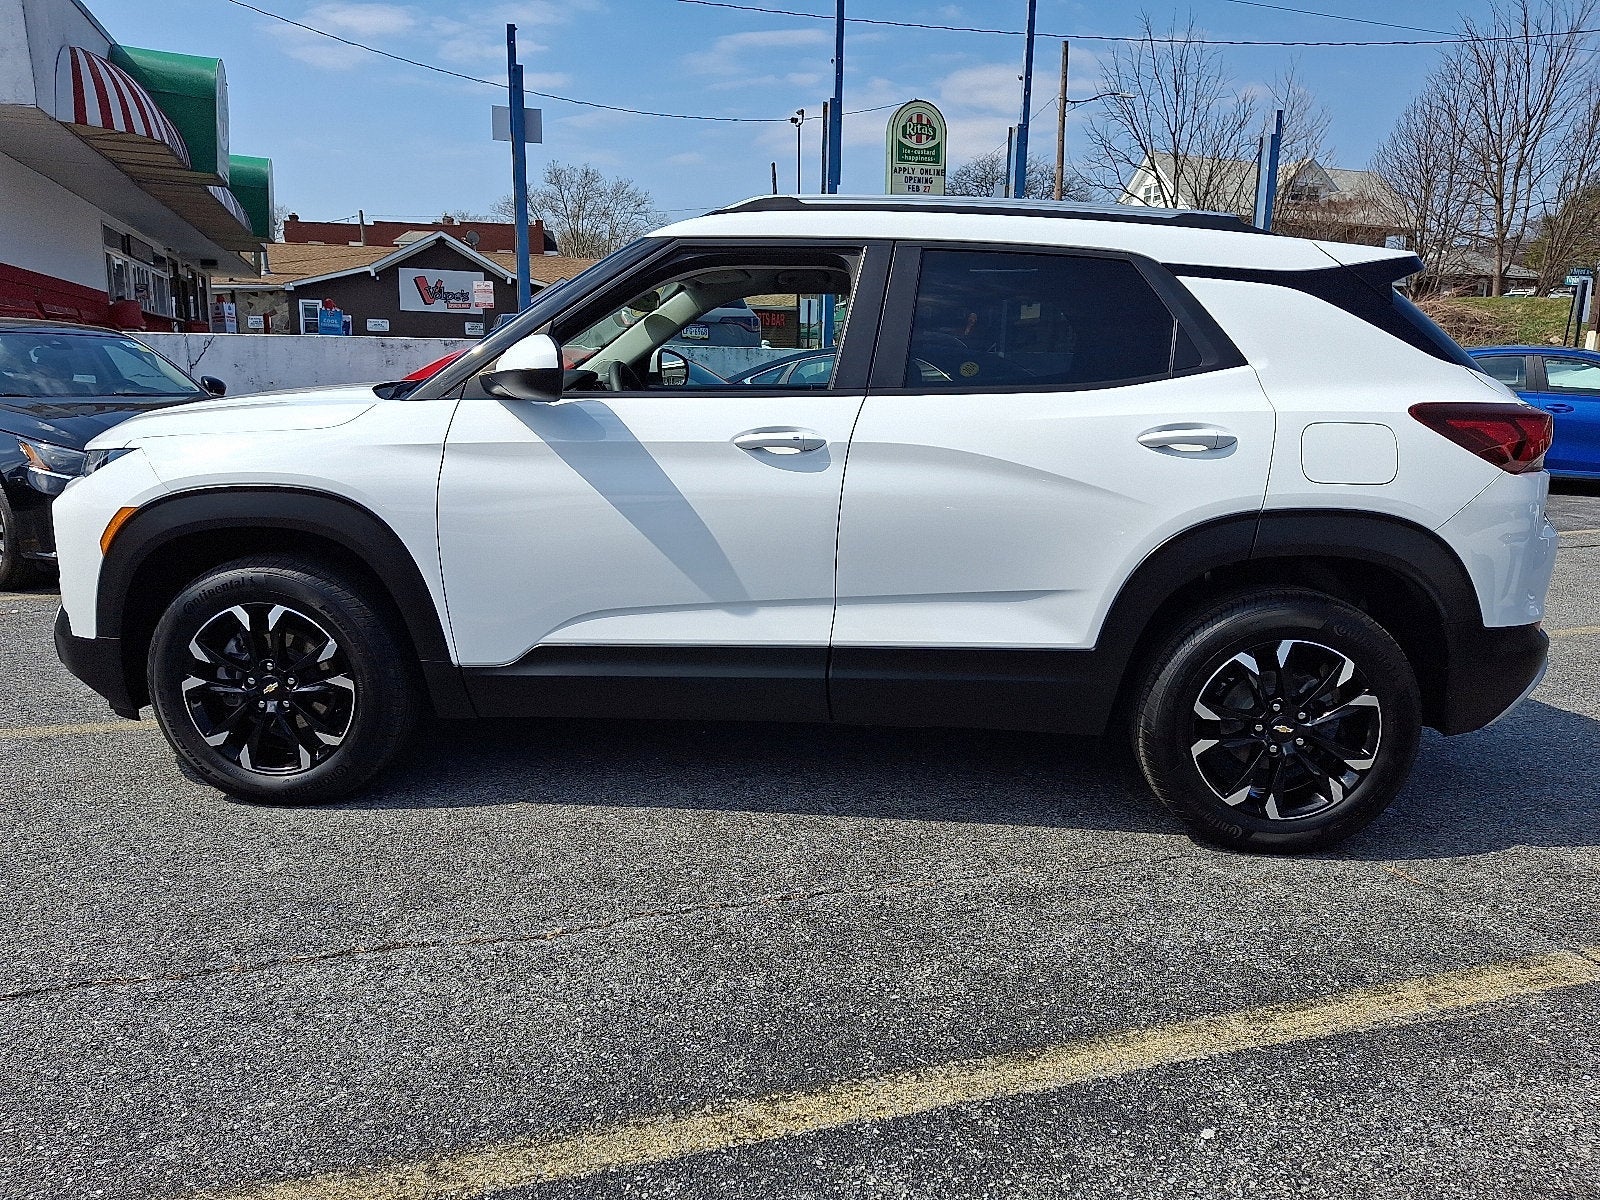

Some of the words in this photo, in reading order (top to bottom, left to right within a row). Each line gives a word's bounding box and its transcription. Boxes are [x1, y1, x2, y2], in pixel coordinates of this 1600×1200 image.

[906, 121, 934, 136] Rita's
[893, 166, 916, 175] APPLY
[919, 168, 945, 177] ONLINE
[904, 176, 934, 185] OPENING
[907, 184, 921, 192] FEB
[922, 185, 931, 193] 27
[422, 284, 470, 303] Volpe's
[771, 313, 785, 327] BAR
